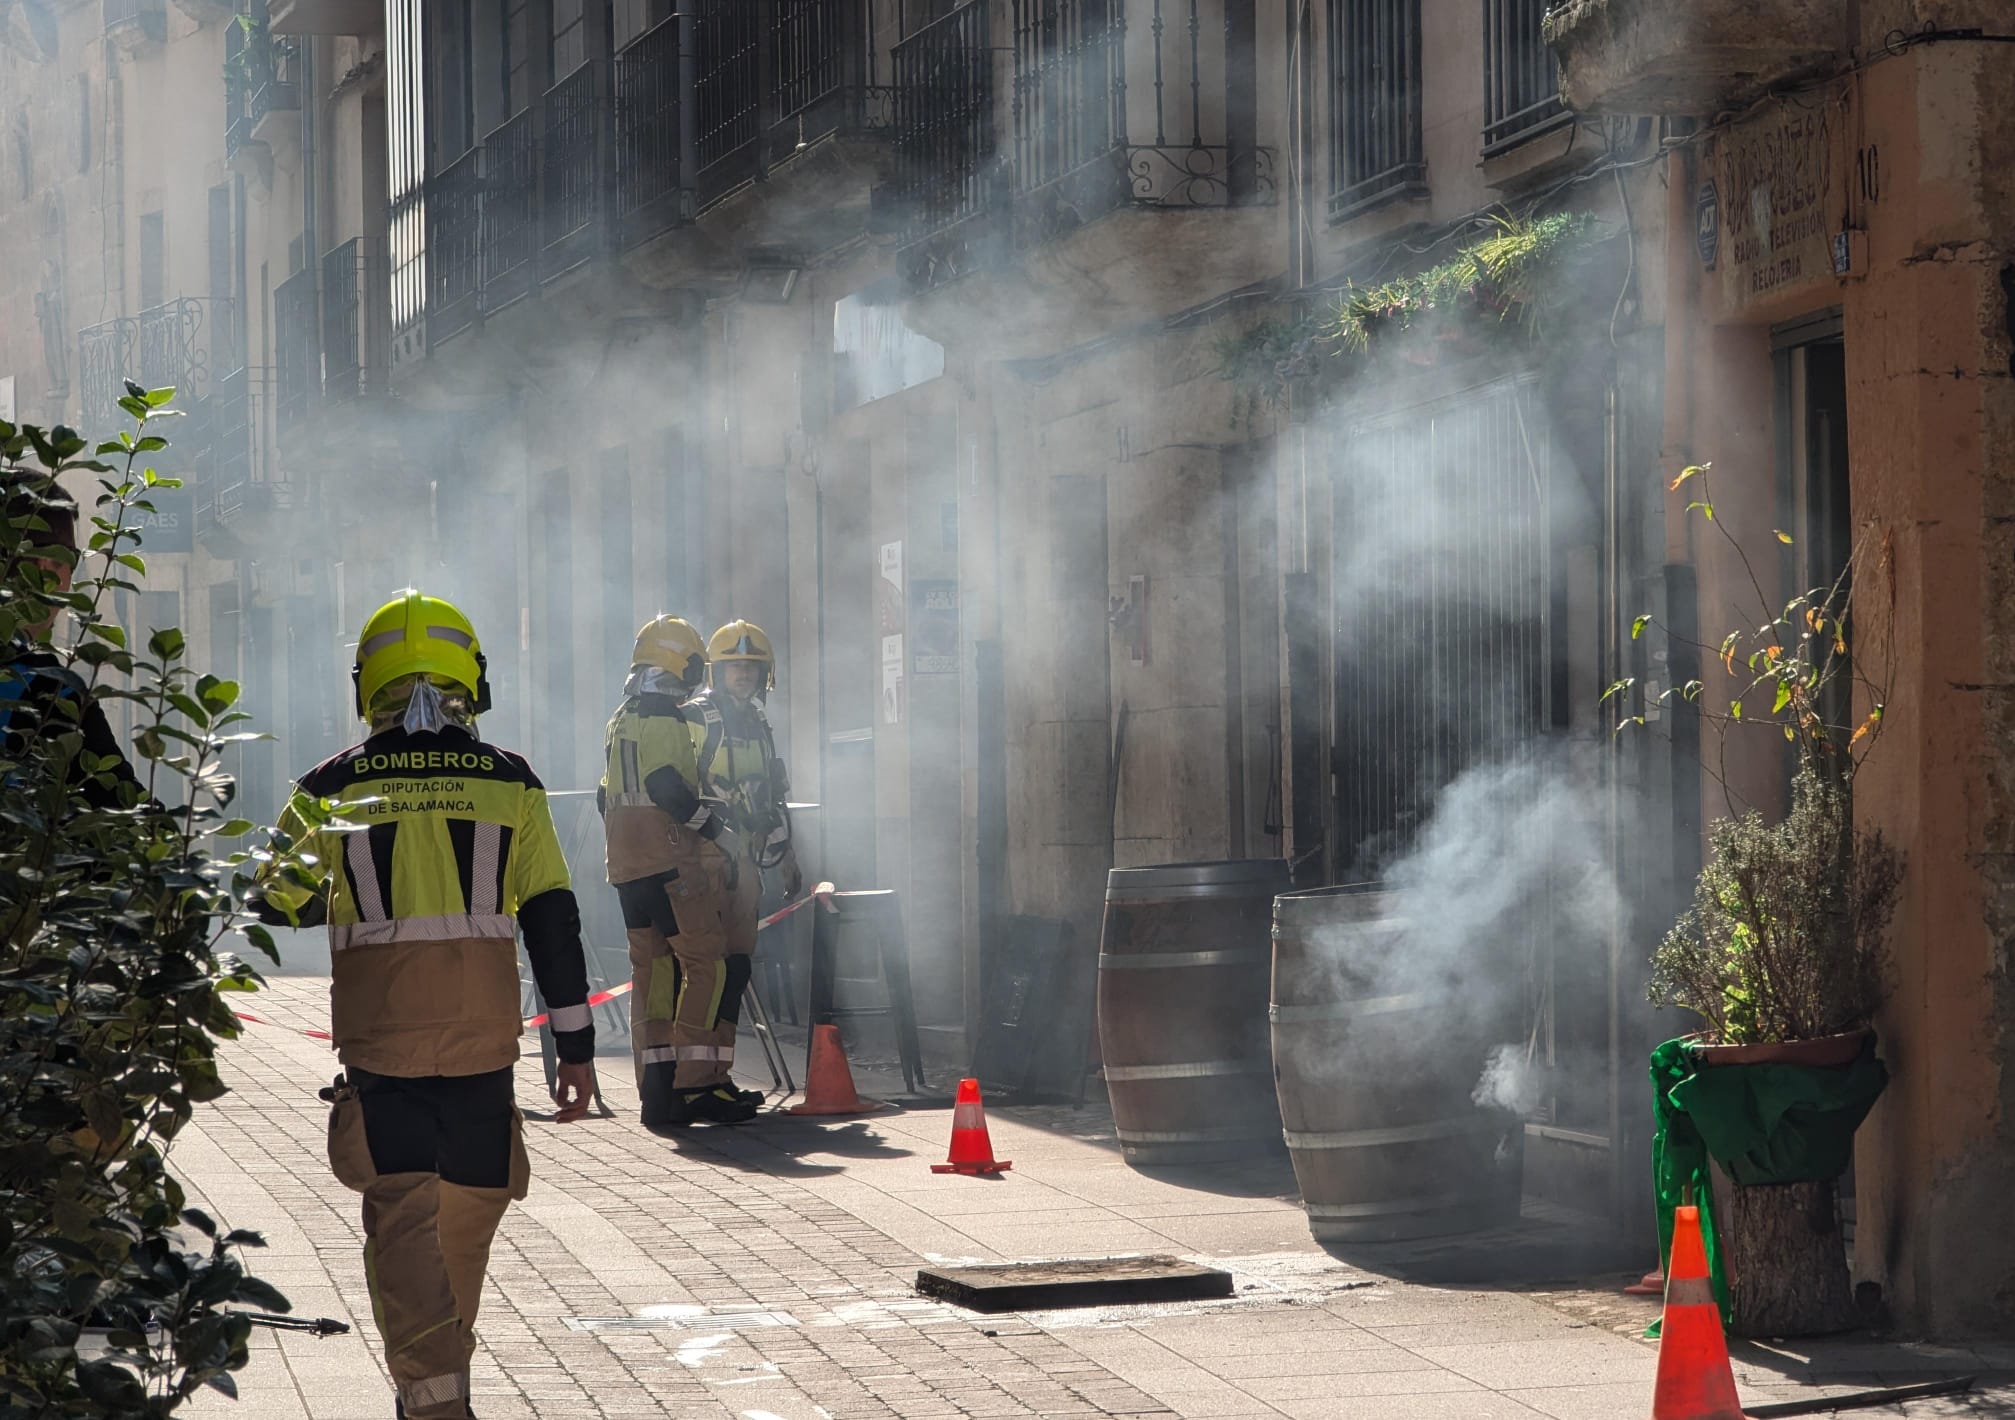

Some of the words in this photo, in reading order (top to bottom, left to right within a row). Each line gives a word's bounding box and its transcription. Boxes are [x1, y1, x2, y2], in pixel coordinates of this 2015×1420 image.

[1857, 143, 1880, 203] 10
[1700, 206, 1715, 233] ADT
[1734, 238, 1760, 265] RADIO
[1752, 258, 1801, 292] RELOJERIA
[132, 512, 178, 528] GAES
[354, 751, 495, 774] BOMBEROS
[381, 779, 465, 794] DIPUTACIÓN
[368, 802, 388, 815] DE
[391, 799, 475, 813] SALAMANCA
